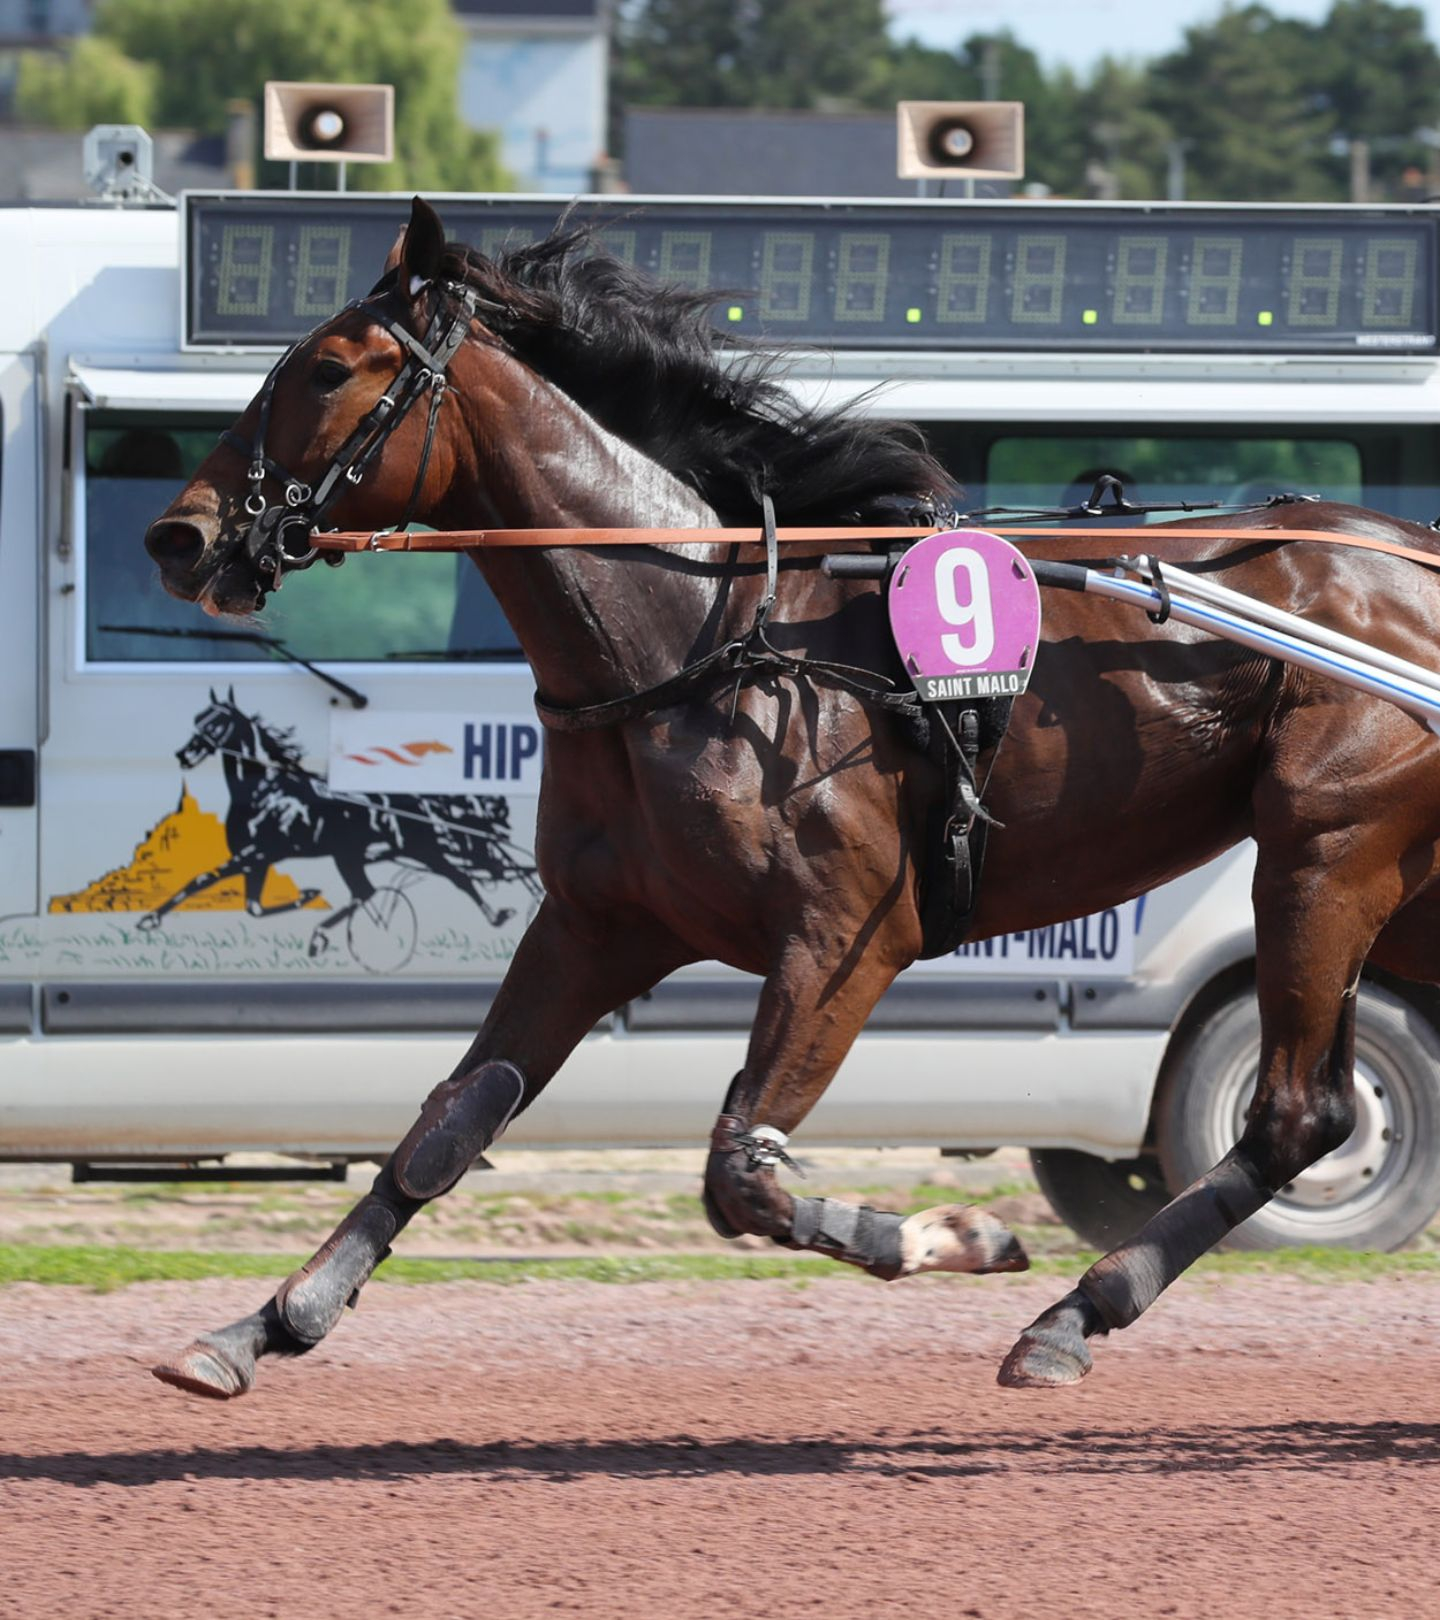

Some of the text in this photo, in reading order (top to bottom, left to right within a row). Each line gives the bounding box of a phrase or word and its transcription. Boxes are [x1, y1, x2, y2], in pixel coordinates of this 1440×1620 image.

[935, 547, 995, 666] 9
[927, 674, 1018, 698] SAINT MALO
[463, 723, 544, 780] HIP
